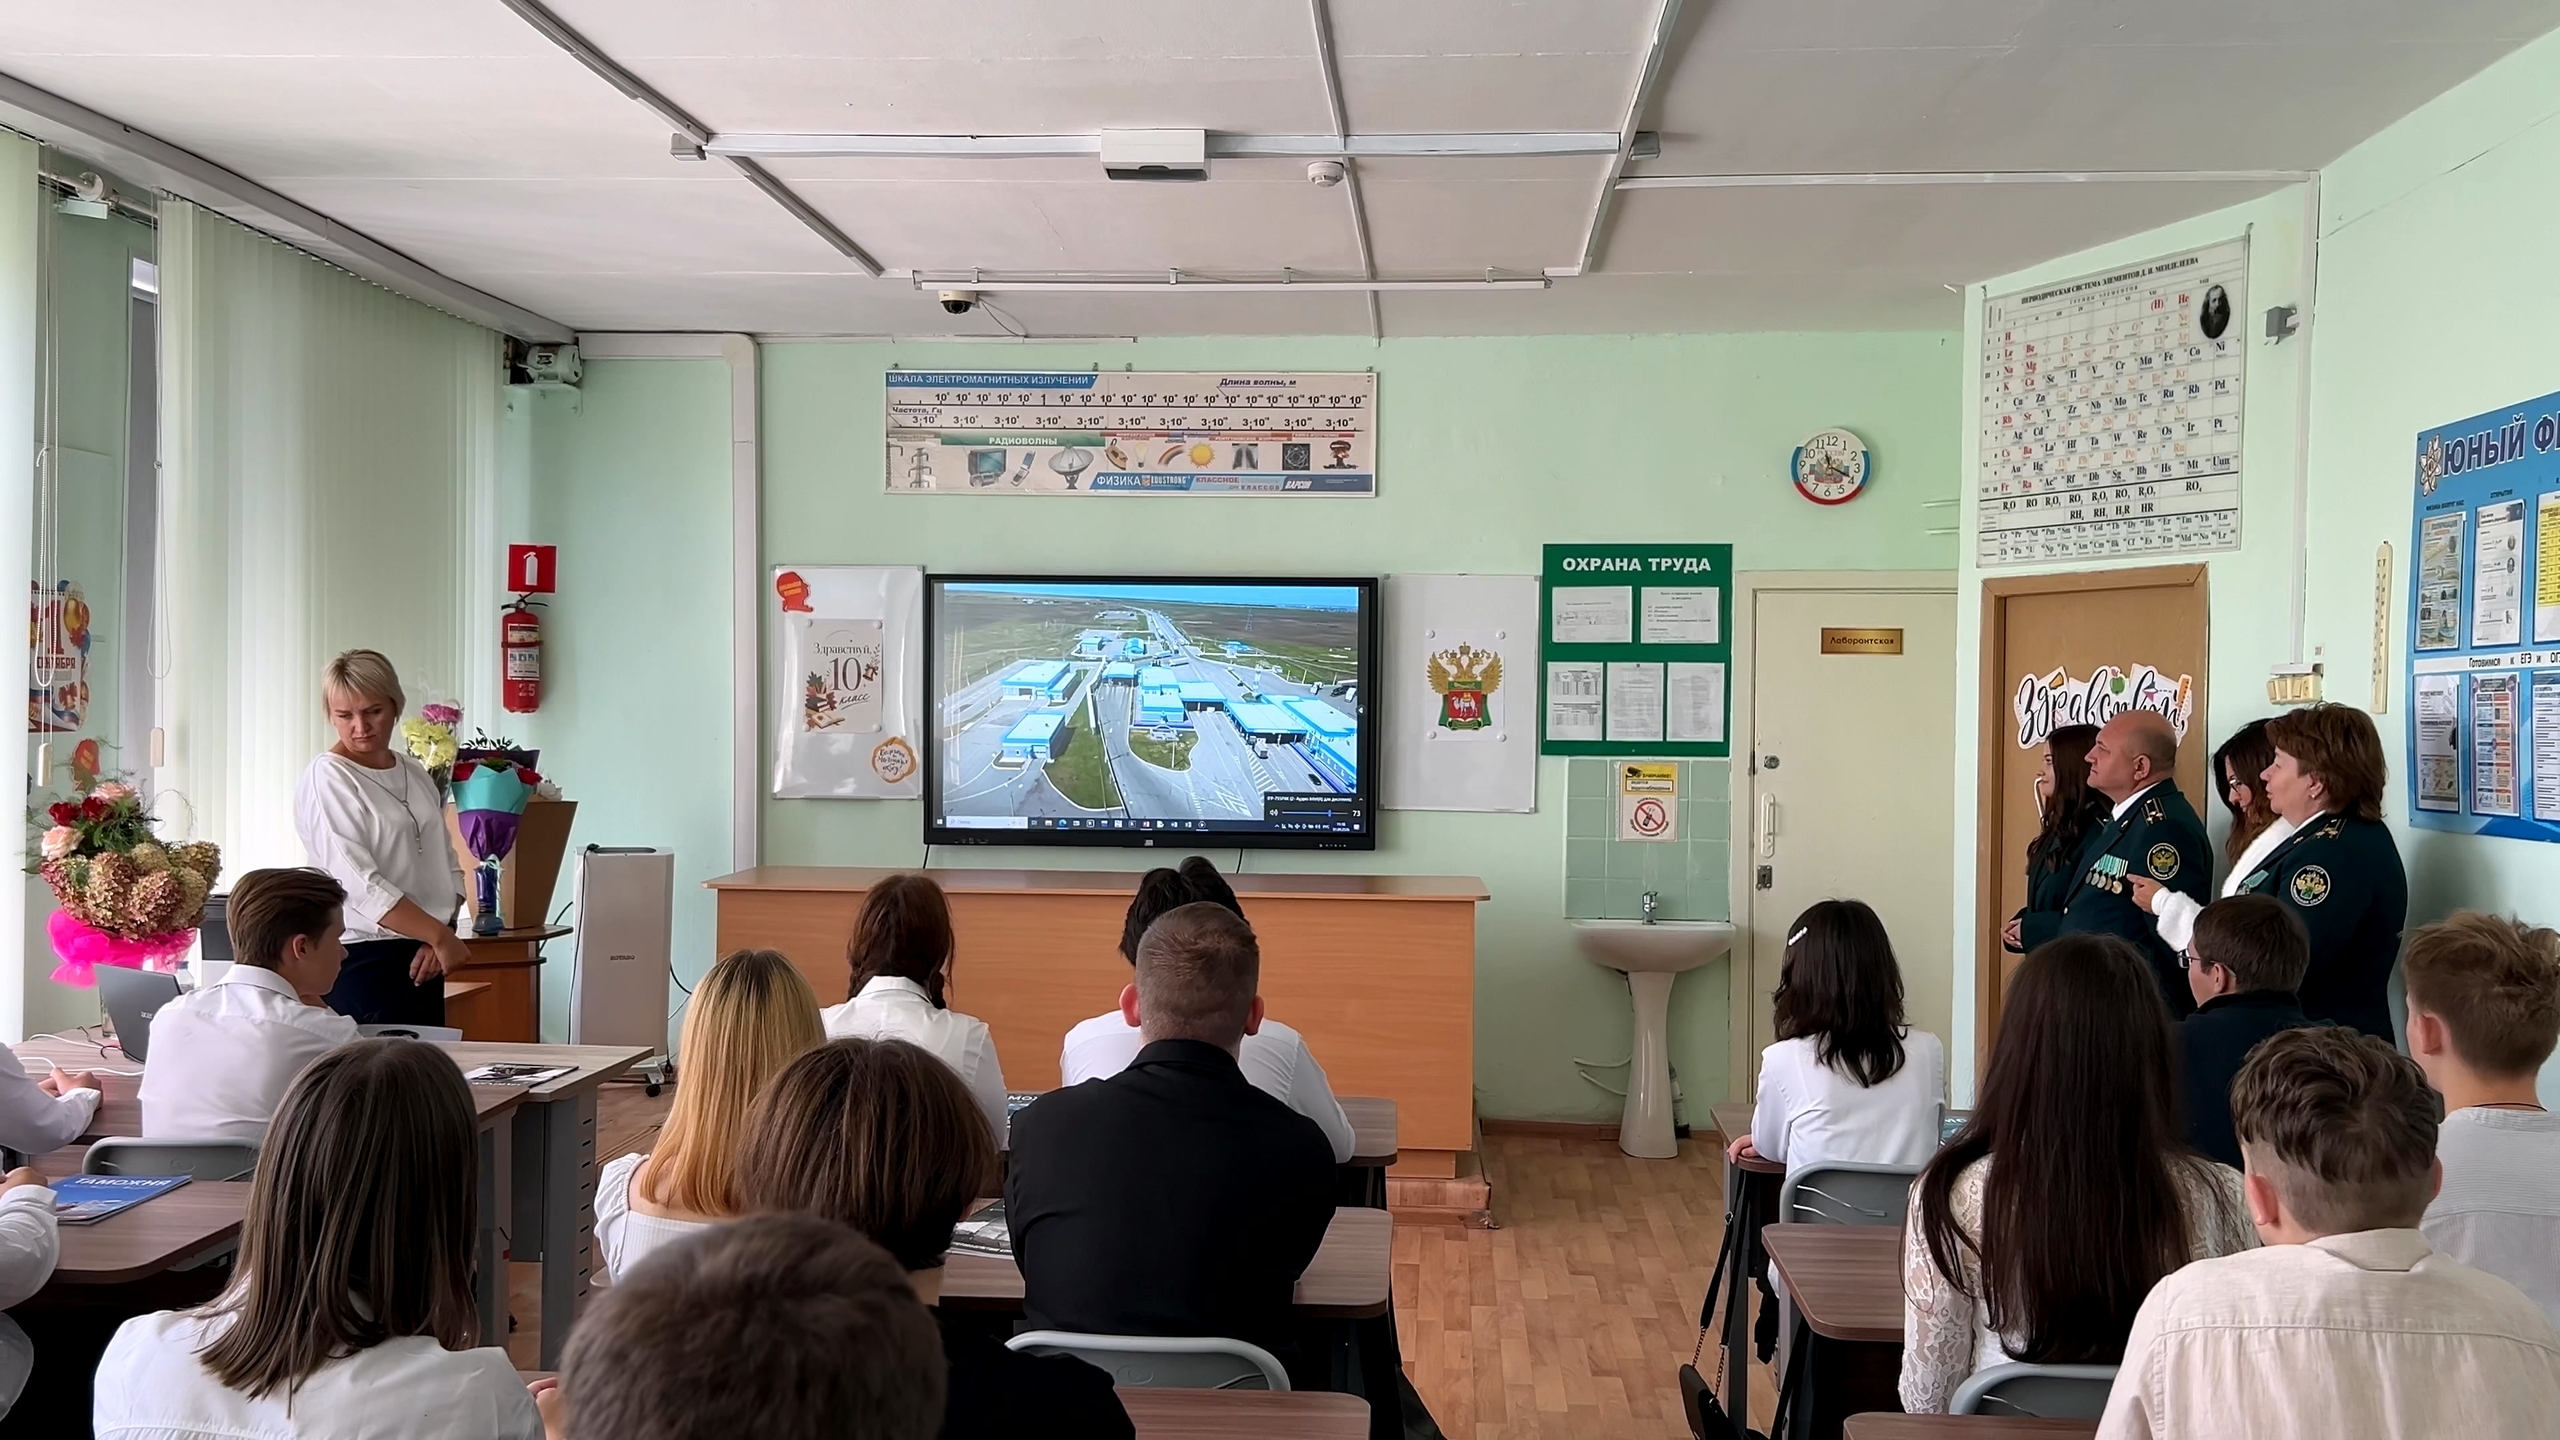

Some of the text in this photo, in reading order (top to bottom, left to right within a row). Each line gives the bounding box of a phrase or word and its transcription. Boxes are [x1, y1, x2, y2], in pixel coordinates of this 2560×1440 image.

[889, 375, 924, 383] ШКАЛА
[926, 376, 1029, 384] ЭЛЕКТРОМАГНИТНЫХ
[1220, 378, 1251, 387] Длина
[1253, 379, 1287, 387] волны,
[892, 406, 929, 414] Частота,
[988, 437, 1058, 446] РАДИОВОЛНЫ
[1816, 439, 1825, 450] 11
[1826, 436, 1838, 446] 12
[1843, 440, 1847, 450] 1
[2442, 410, 2560, 478] ЮНЫЙ Ф
[1804, 448, 1816, 458] 10
[1850, 450, 1858, 461] 2
[1799, 460, 1806, 470] 9
[1854, 463, 1860, 474] 3
[1096, 475, 1141, 486] ФИЗИКА
[1802, 473, 1808, 484] 8
[1848, 475, 1854, 485] 4
[1812, 483, 1819, 493] 7
[1824, 488, 1831, 497] 6
[1838, 484, 1845, 494] 5
[1562, 558, 1712, 574] ОХРАНА ТРУДА
[1830, 636, 1894, 646] Лаборантская
[813, 642, 872, 657] Здравствуй,
[2468, 657, 2500, 668] Готовимся
[2520, 653, 2532, 664] ЕГЭ
[2536, 655, 2541, 663] и
[829, 657, 862, 691] 10
[518, 683, 536, 696] 25
[839, 693, 871, 705] класс
[75, 1178, 172, 1186] ТАМОЖНЯ
